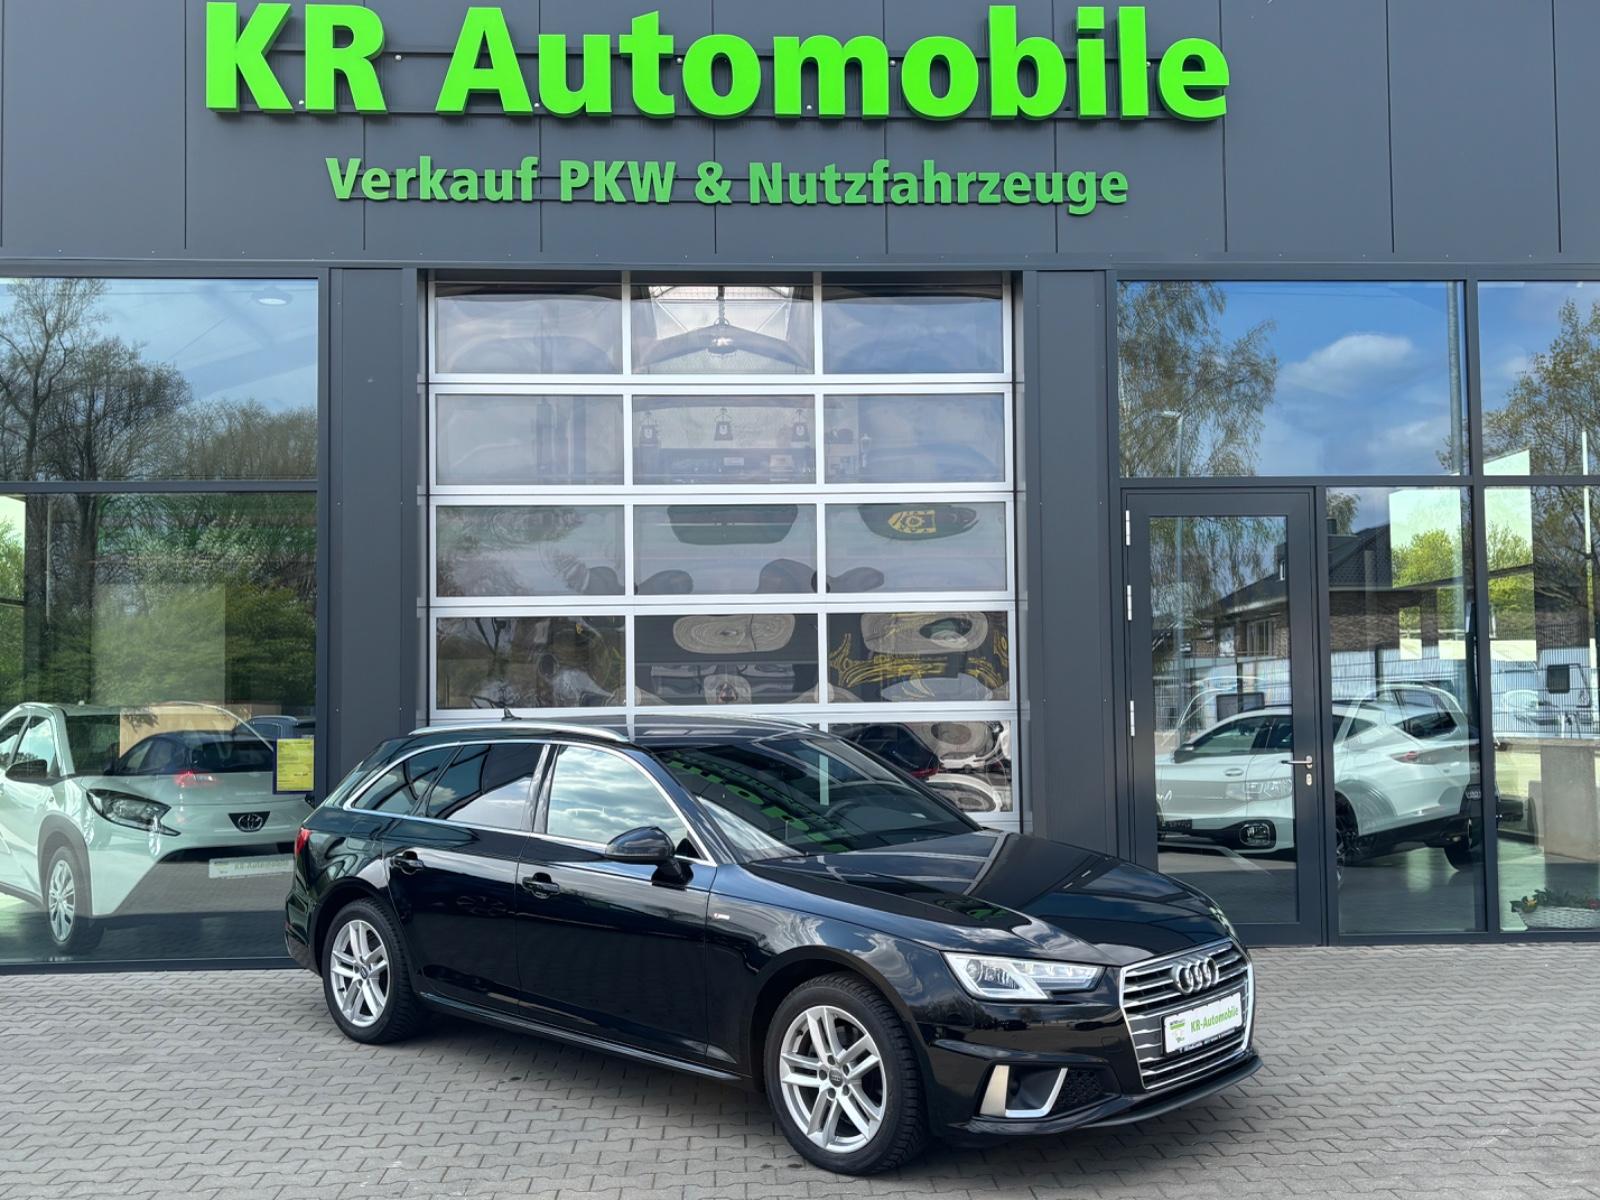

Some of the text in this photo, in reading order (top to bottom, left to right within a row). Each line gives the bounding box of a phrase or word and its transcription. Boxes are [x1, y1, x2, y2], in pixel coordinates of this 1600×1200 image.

[206, 1, 1230, 119] KR Automobile
[325, 155, 1129, 216] Verkauf PKW & Nutzfahrzeuge
